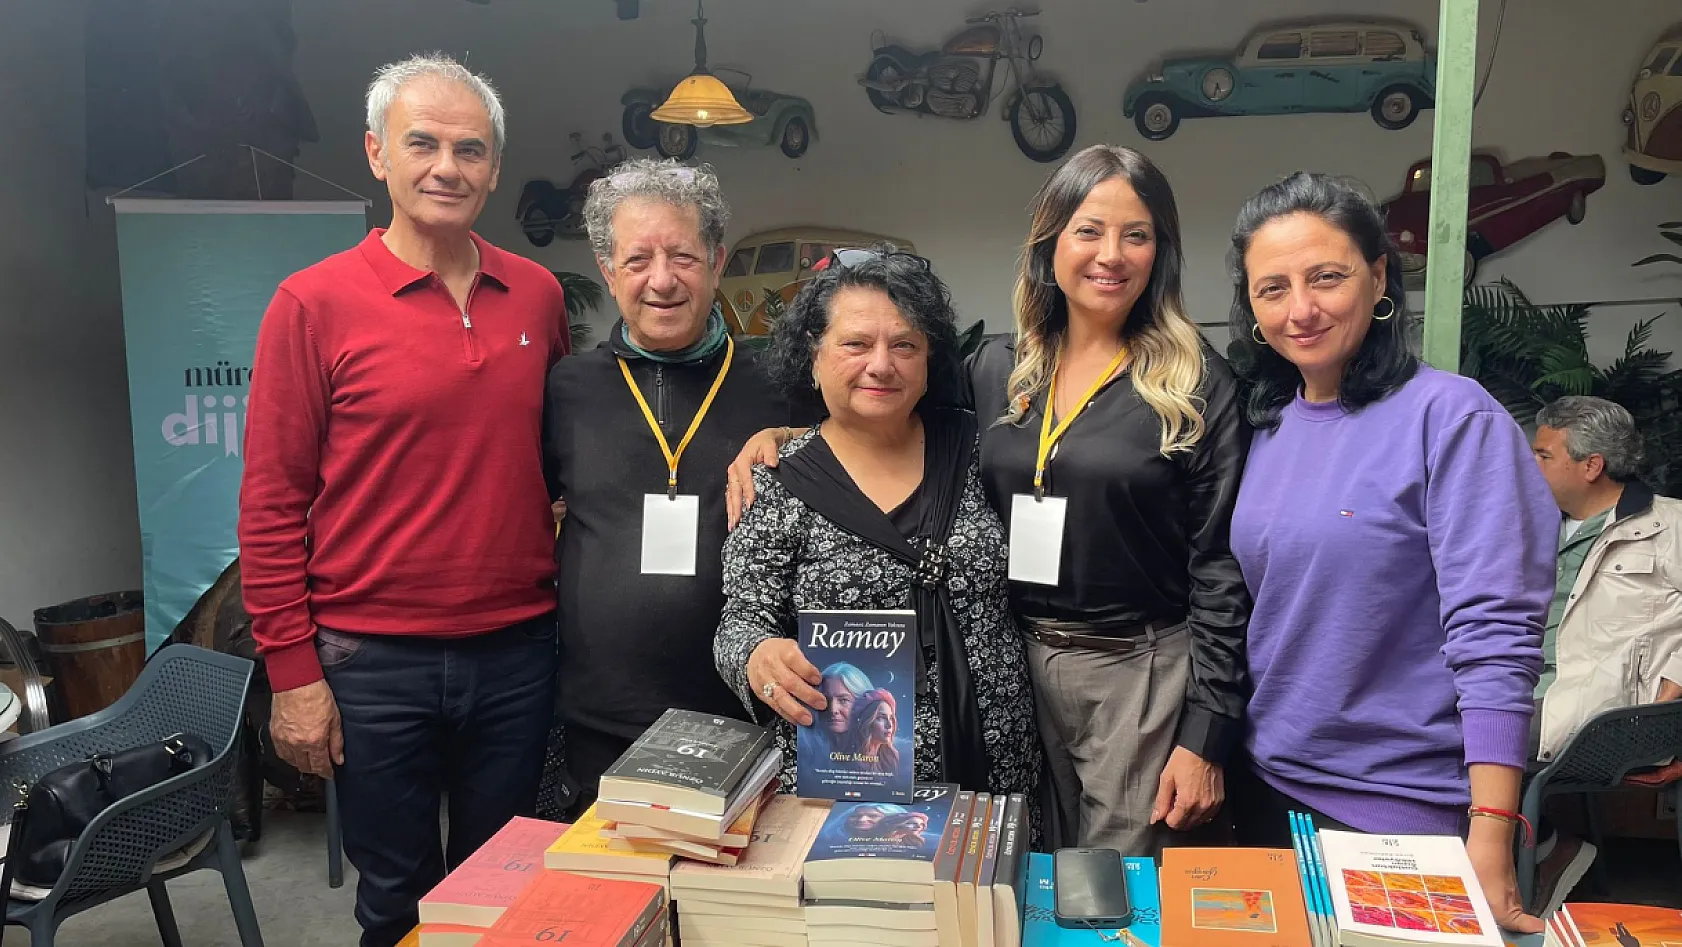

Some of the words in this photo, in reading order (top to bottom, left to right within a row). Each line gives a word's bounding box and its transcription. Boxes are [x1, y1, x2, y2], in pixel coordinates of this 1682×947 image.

[807, 622, 906, 658] Ramay
[677, 745, 709, 759] 19
[829, 751, 851, 761] Olive
[851, 753, 880, 763] Maron
[503, 859, 533, 872] 19
[535, 925, 574, 944] 19
